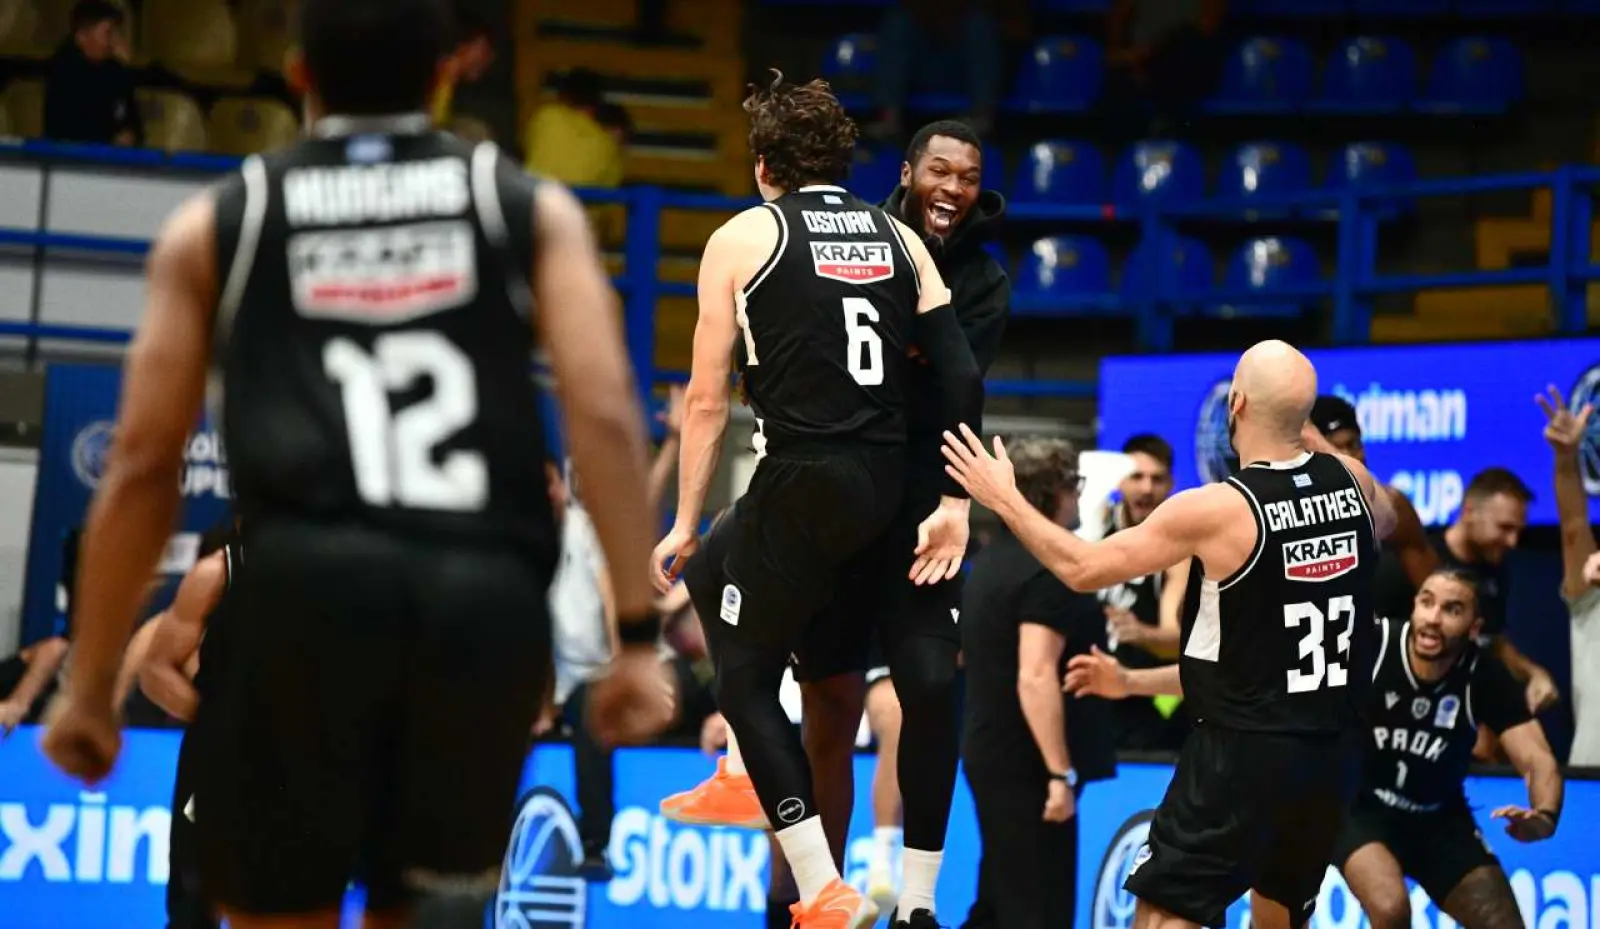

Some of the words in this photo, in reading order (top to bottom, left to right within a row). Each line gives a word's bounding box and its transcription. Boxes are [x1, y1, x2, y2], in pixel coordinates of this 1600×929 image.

[801, 209, 878, 234] OSMAN
[813, 244, 889, 262] KRAFT
[842, 297, 884, 386] 6
[323, 330, 490, 512] 12
[1264, 487, 1361, 532] CALATHES
[1285, 534, 1356, 564] KRAFT
[1305, 562, 1341, 575] PAINTS
[1284, 595, 1356, 694] 33
[1395, 759, 1409, 789] 1
